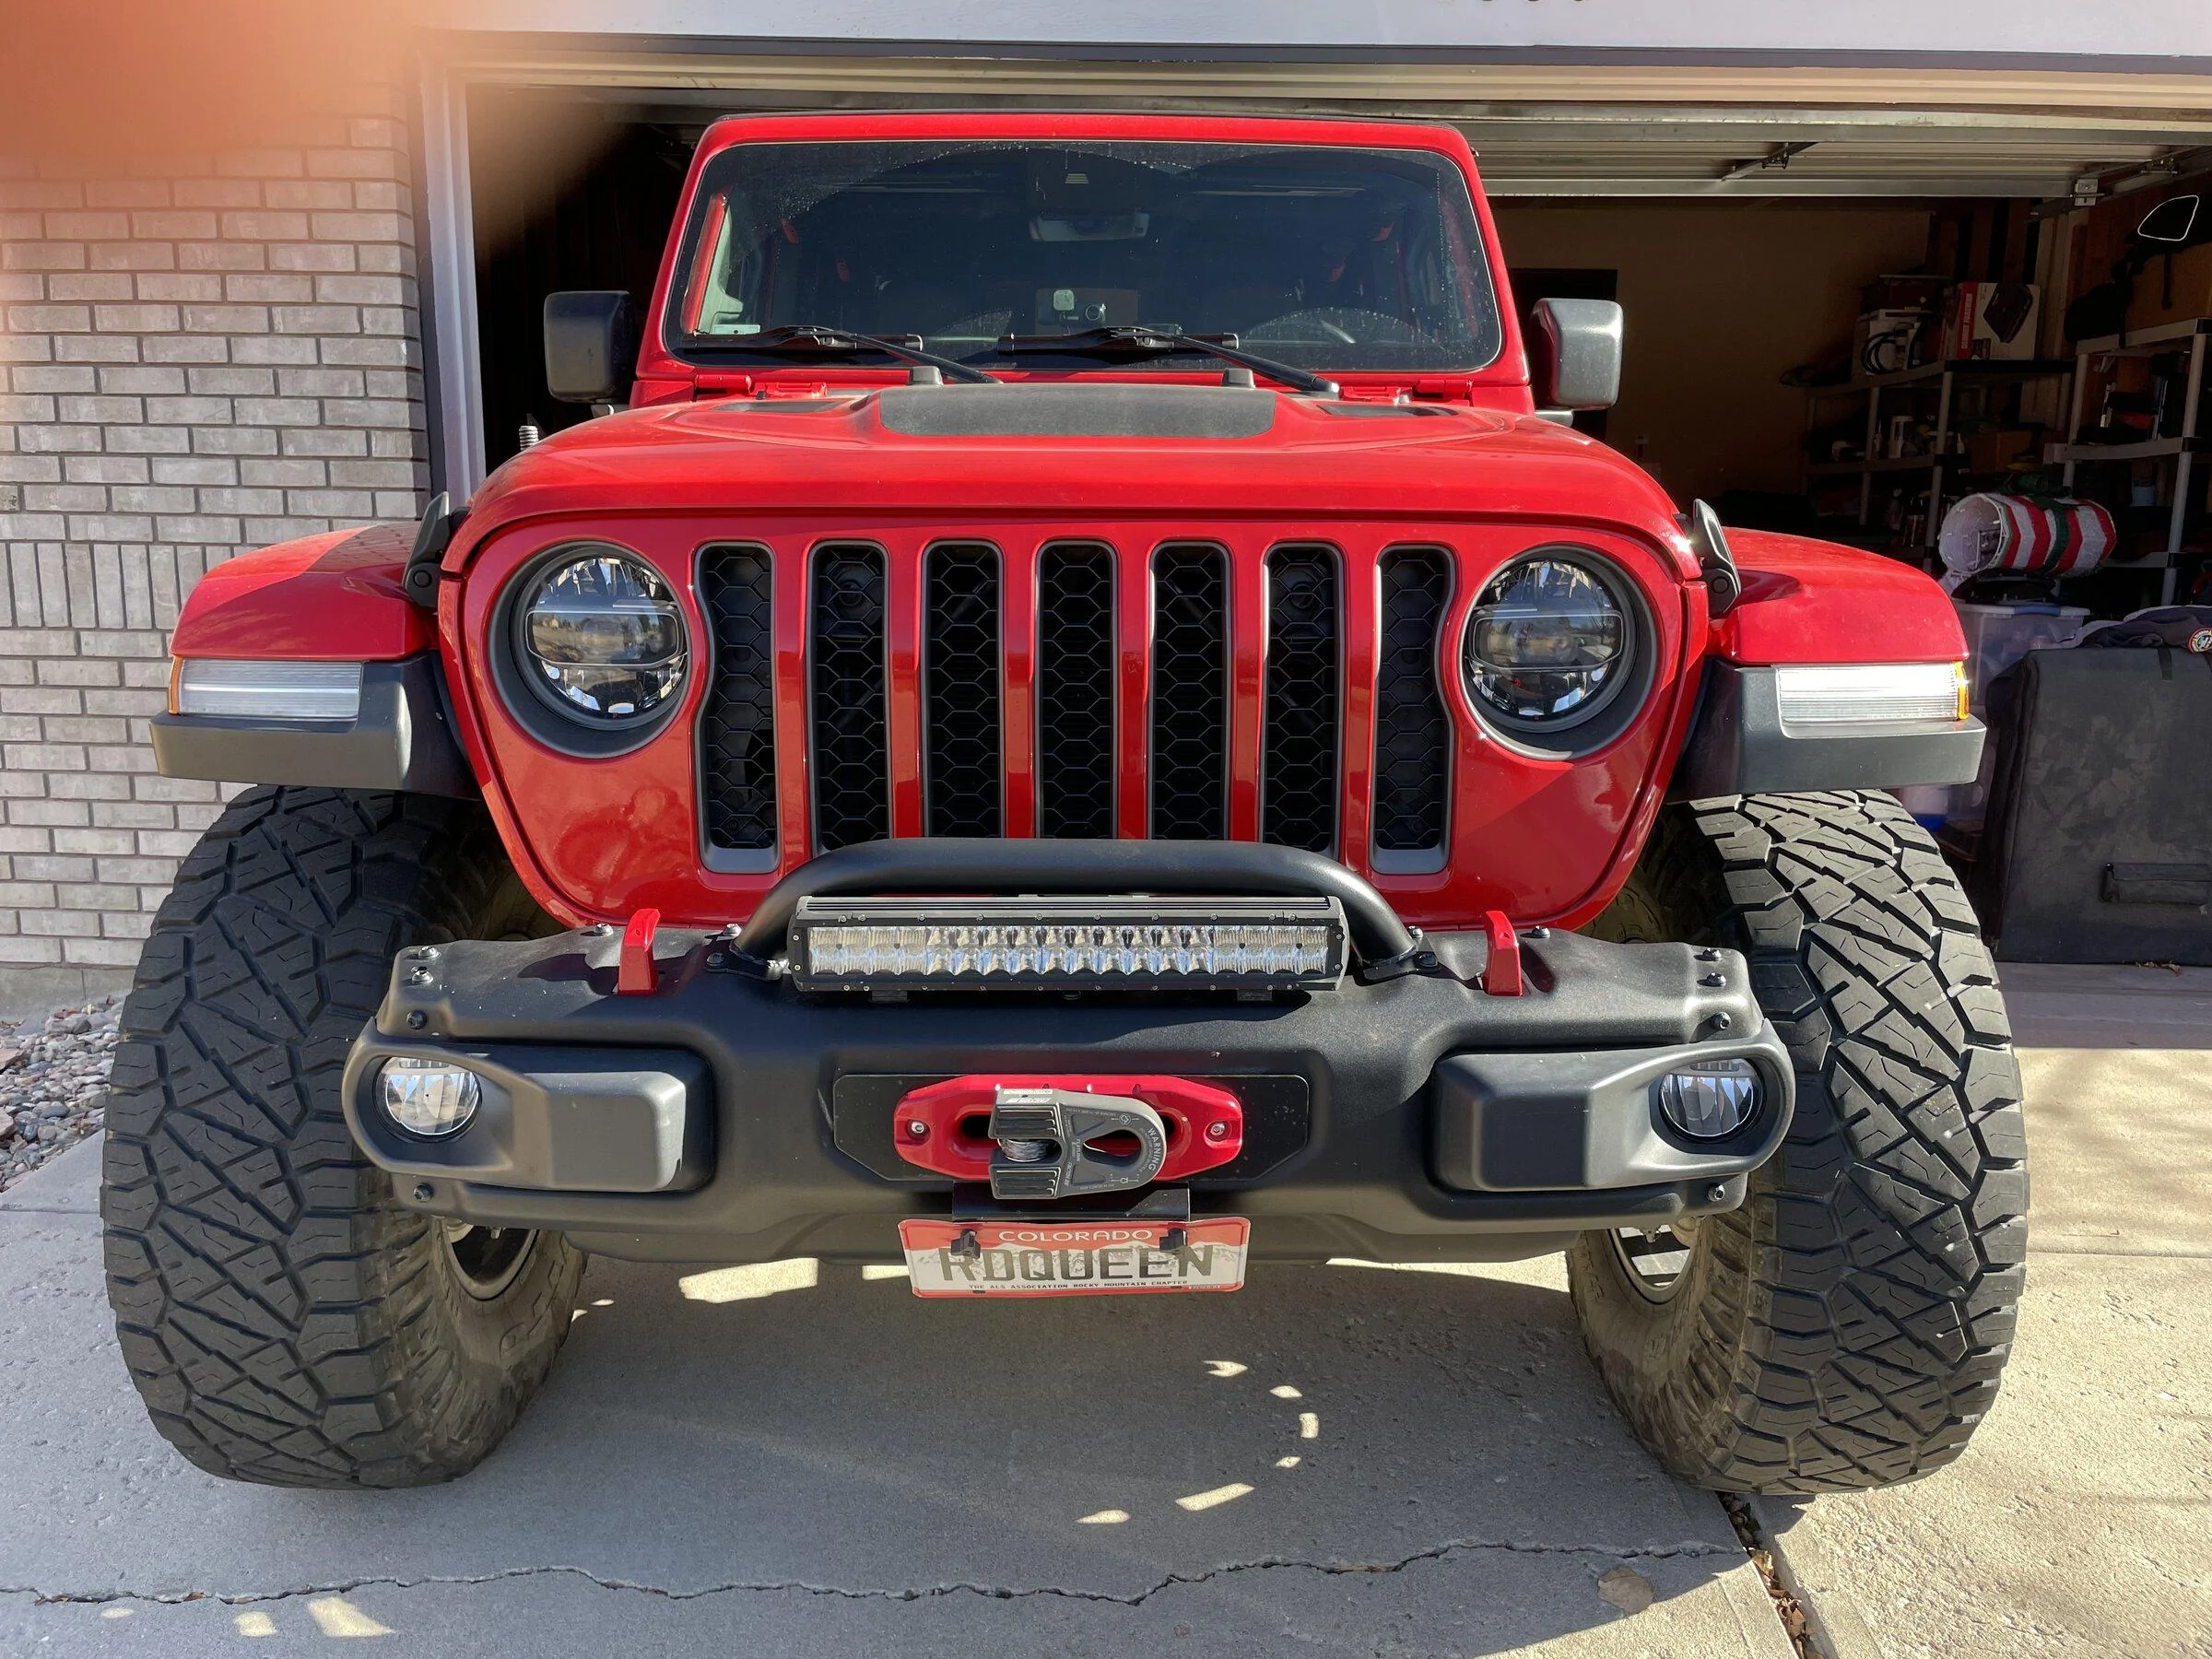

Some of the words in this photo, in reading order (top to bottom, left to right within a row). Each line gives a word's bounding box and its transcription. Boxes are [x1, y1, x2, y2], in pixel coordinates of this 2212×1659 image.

[1147, 1127, 1161, 1171] WARNING
[998, 1230, 1152, 1241] COLORADO
[938, 1246, 1214, 1281] RDQUEEN
